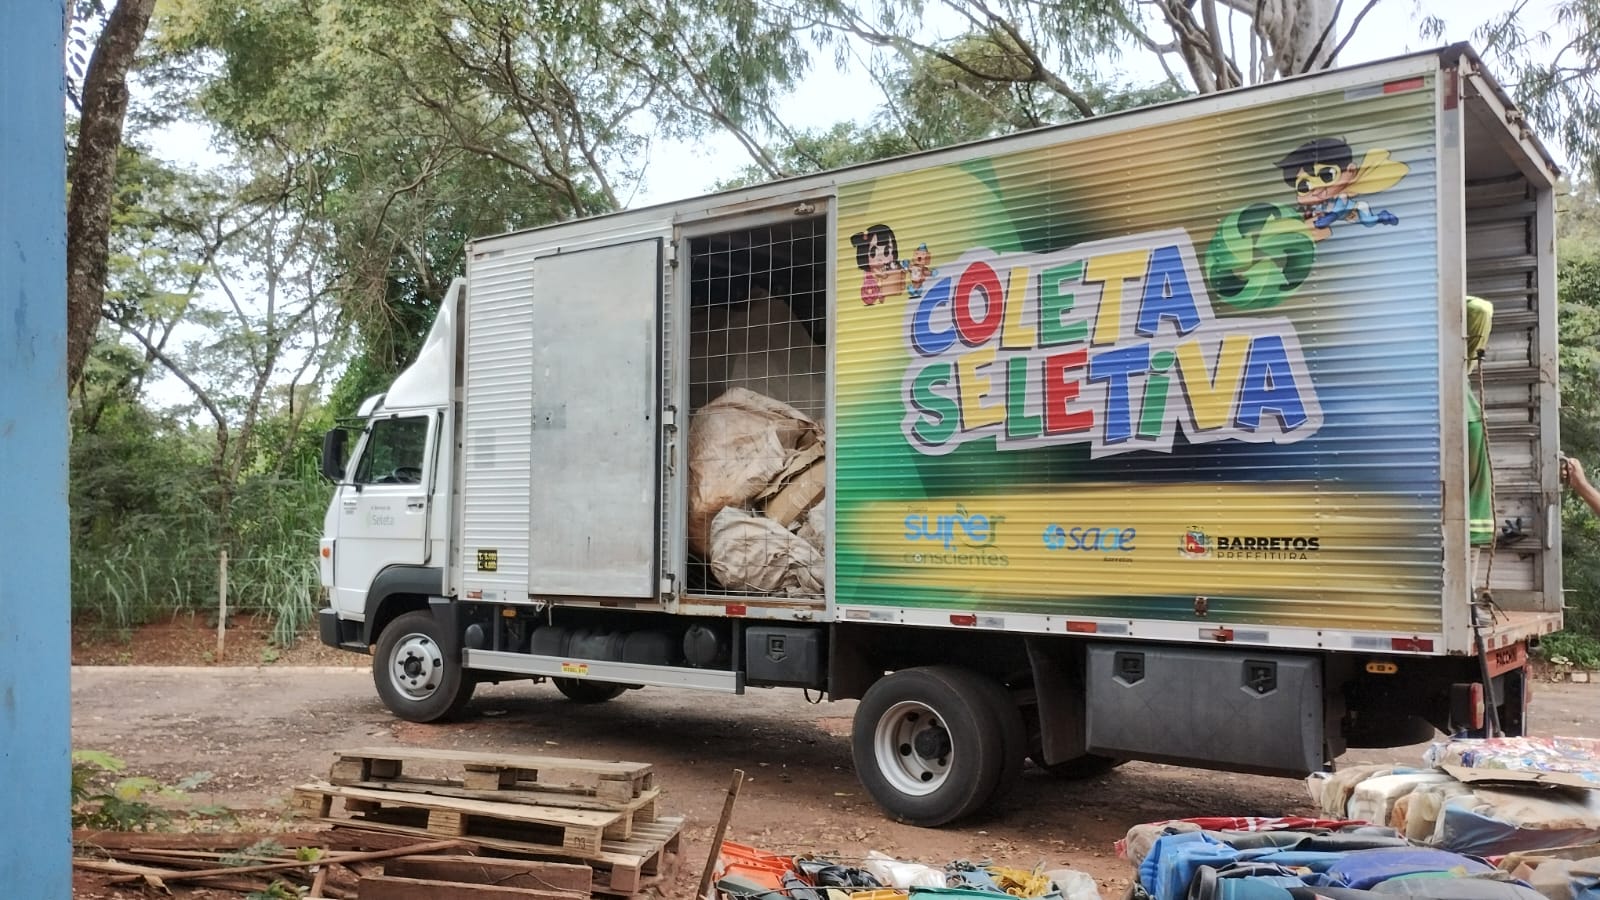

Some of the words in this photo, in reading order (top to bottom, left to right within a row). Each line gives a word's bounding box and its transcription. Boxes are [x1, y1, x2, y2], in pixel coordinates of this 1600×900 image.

[912, 245, 1202, 355] COLETA
[1067, 527, 1136, 551] saae
[1217, 537, 1320, 551] BARRETOS
[1217, 552, 1307, 560] PREFEITURA
